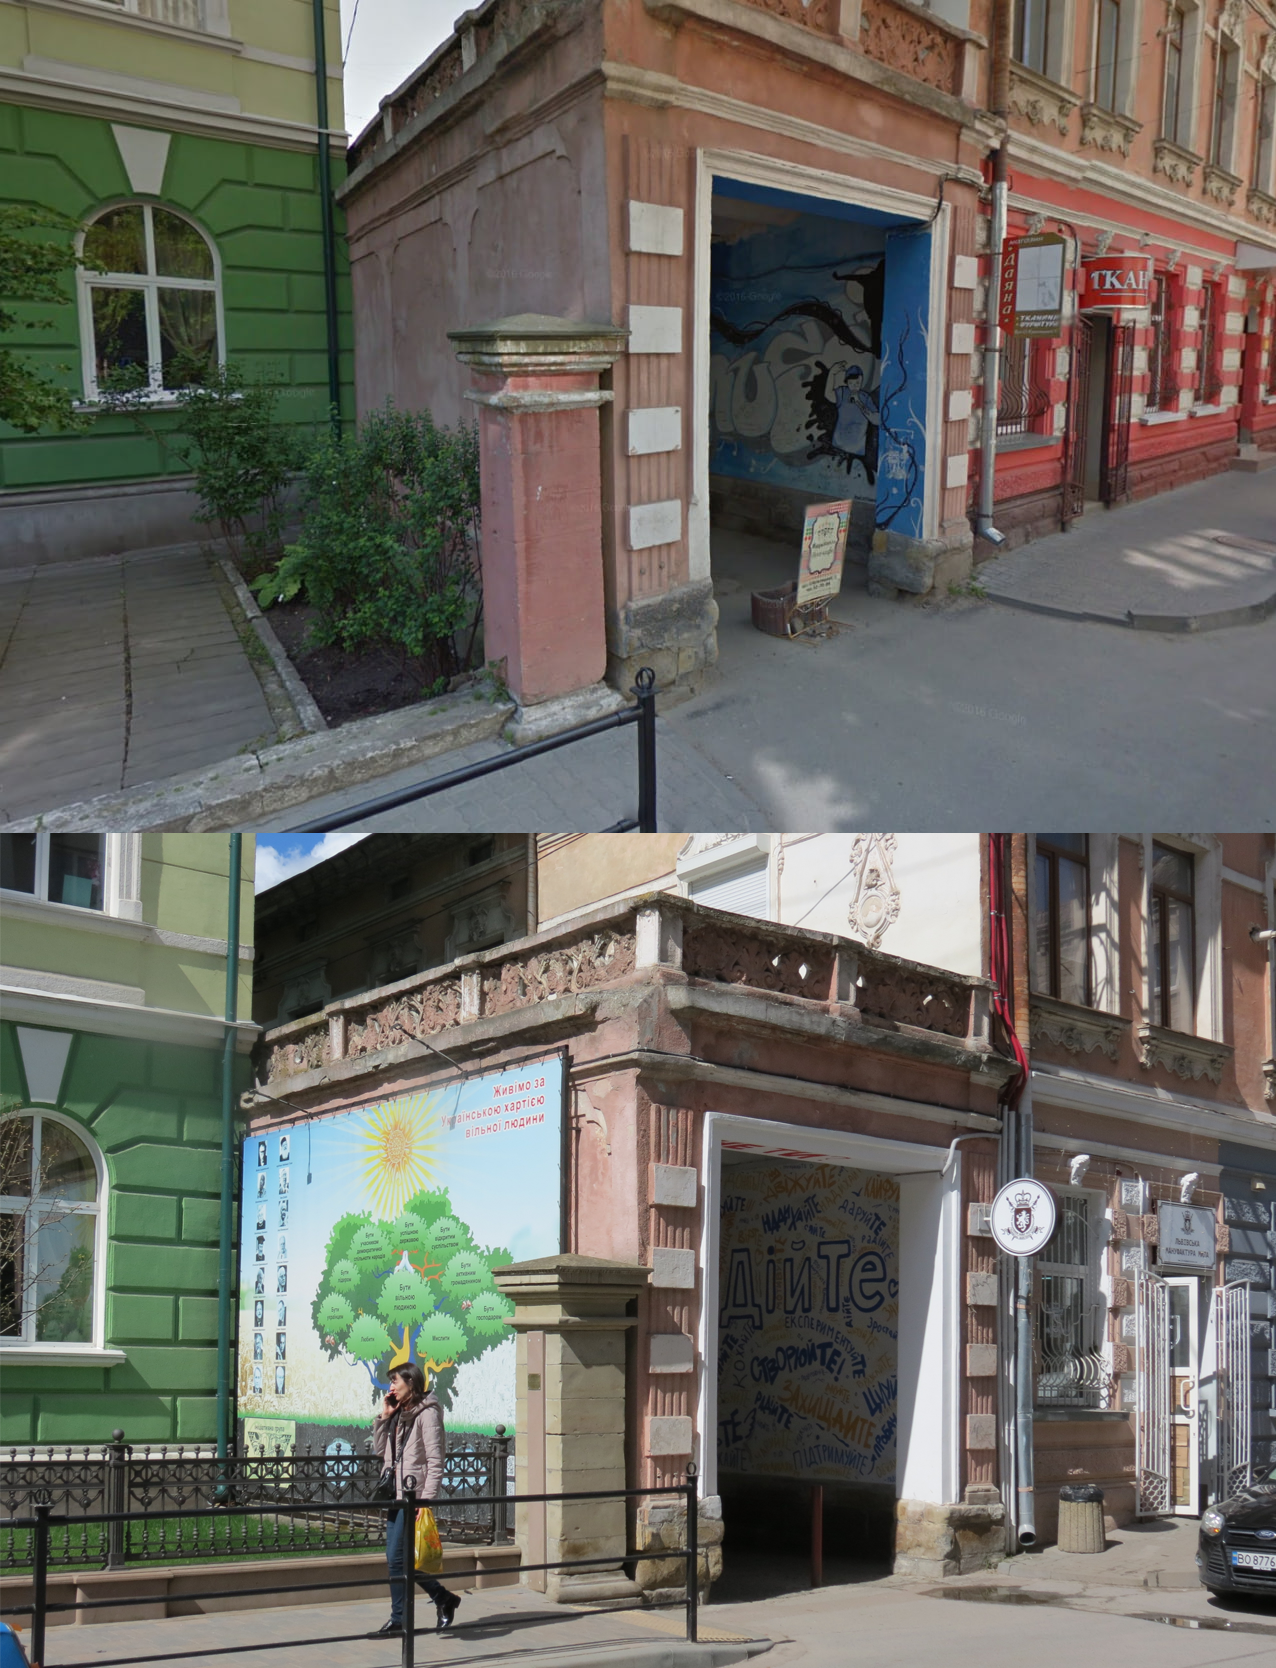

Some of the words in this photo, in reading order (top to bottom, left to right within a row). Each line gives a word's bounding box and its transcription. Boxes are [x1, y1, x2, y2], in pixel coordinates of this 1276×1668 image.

[493, 1081, 531, 1098] Живімо
[534, 1077, 545, 1089] за
[504, 1095, 545, 1113] хартією
[466, 1119, 502, 1138] вільної
[504, 1113, 545, 1130] людини
[399, 1283, 411, 1291] Бути
[395, 1294, 415, 1302] вільною
[394, 1303, 416, 1311] людиною
[1253, 1555, 1276, 1567] 8776
